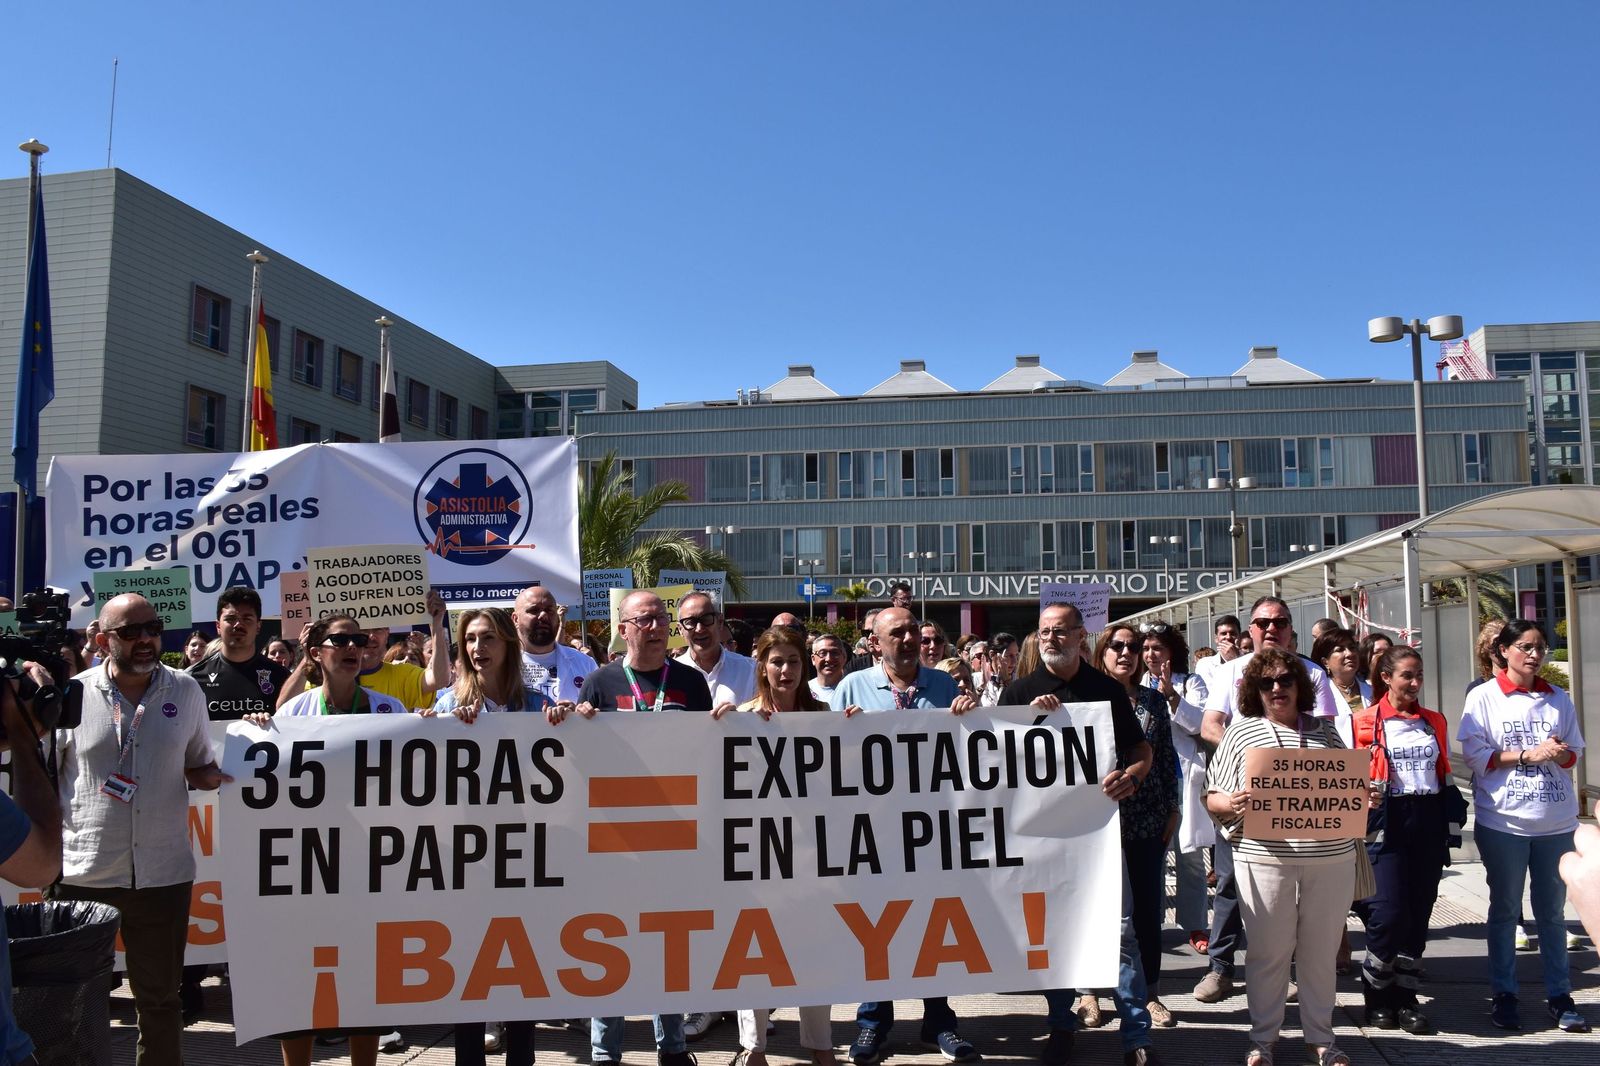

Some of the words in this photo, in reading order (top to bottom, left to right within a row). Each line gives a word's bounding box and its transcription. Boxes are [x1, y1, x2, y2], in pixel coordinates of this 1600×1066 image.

[83, 474, 151, 502] Por
[164, 472, 215, 500] las
[226, 467, 269, 493] 35
[440, 497, 506, 513] ASISTOLIA
[83, 507, 195, 536] horas
[207, 494, 320, 525] reales
[440, 514, 508, 525] ADMINISTRATIVA
[84, 545, 132, 569] en
[145, 534, 178, 561] el
[192, 529, 256, 559] 061
[314, 555, 422, 570] TRABAJADORES
[114, 578, 126, 588] 35
[130, 576, 170, 587] HORAS
[170, 559, 281, 594] UAP
[315, 570, 424, 588] AGODOTADOS
[584, 572, 624, 580] PERSONAL
[663, 576, 723, 585] TRABAJADORES
[1156, 573, 1188, 592] DE
[583, 581, 613, 589] ICIENTE
[150, 587, 187, 598] BASTA
[318, 592, 336, 603] LO
[340, 587, 393, 601] SUFREN
[398, 586, 424, 597] LOS
[455, 589, 469, 599] se
[473, 588, 484, 598] lo
[487, 588, 525, 598] mere
[287, 609, 303, 619] DE
[319, 602, 426, 619] CDADANOS
[208, 697, 265, 712] ceuta
[1503, 735, 1524, 747] SER
[722, 714, 1099, 799] EXPLOTACIÓN
[1273, 759, 1289, 772] 35
[1293, 759, 1346, 772] HORAS
[1388, 762, 1403, 772] ER
[1406, 760, 1425, 771] DEL
[1514, 764, 1554, 778] PENA
[241, 740, 326, 810] 35
[353, 737, 565, 807] HORAS
[1250, 777, 1314, 791] REALES,
[1318, 777, 1366, 789] BASTA
[1507, 779, 1564, 791] ABANDONO
[1507, 790, 1567, 803] PERPETUO
[1252, 799, 1272, 811] DE
[1277, 797, 1362, 811] TRAMPAS
[1271, 817, 1342, 829] FISCALES
[723, 816, 793, 881] EN
[815, 813, 882, 877] LA
[902, 807, 1023, 872] PIEL
[258, 826, 340, 896] EN
[368, 822, 565, 893] PAPEL
